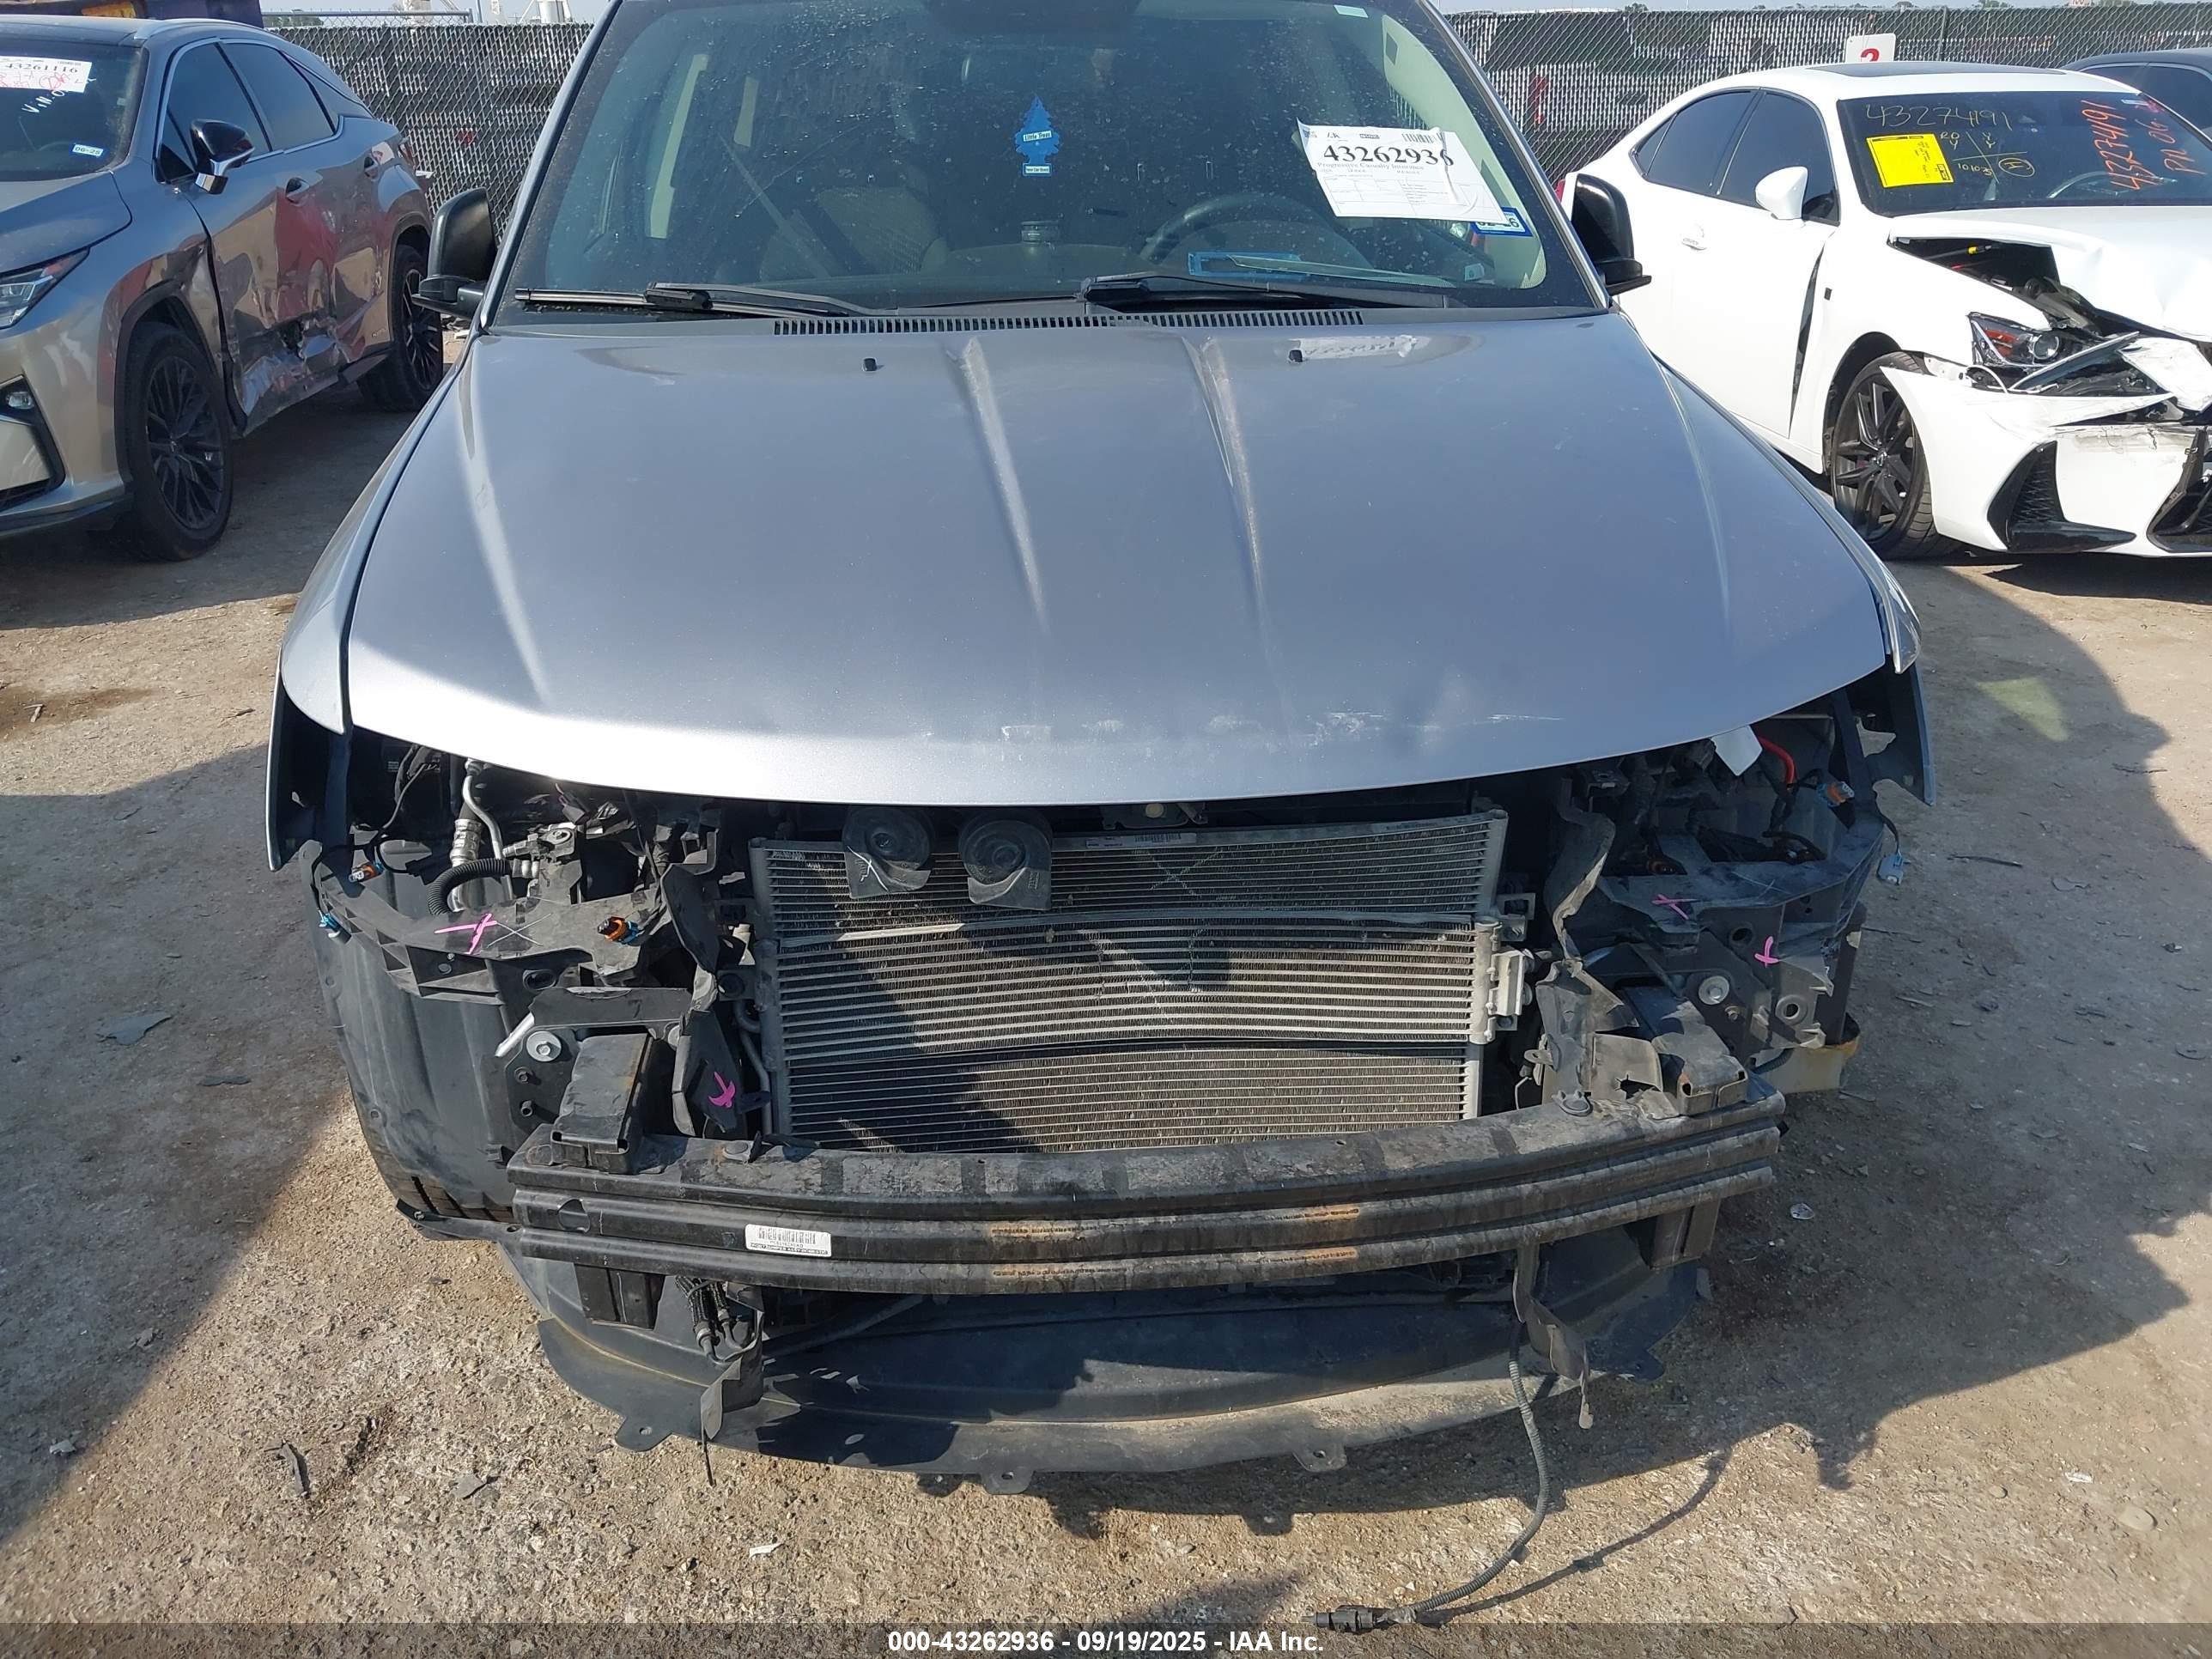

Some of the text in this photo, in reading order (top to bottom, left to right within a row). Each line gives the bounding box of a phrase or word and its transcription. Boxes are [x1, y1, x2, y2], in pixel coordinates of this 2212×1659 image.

[6, 64, 78, 74] 43261116
[1865, 103, 2013, 131] 43274191
[1323, 144, 1454, 167] 43262936
